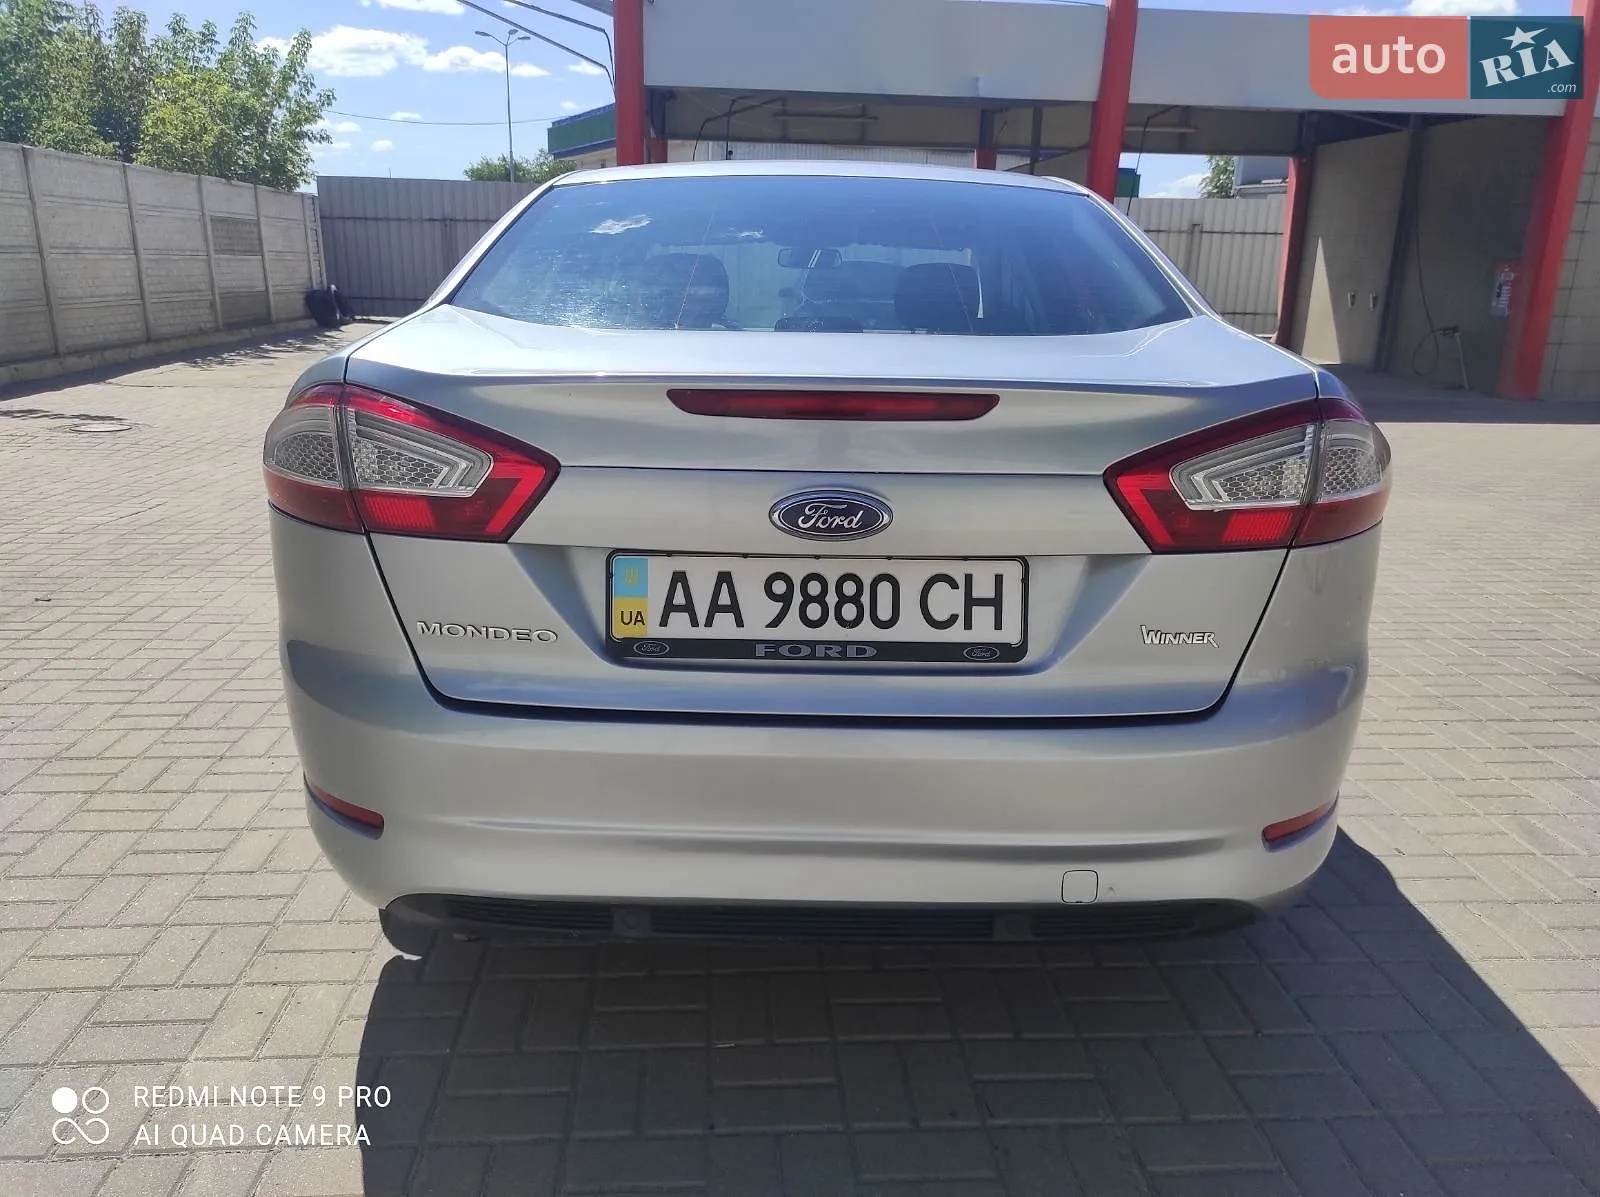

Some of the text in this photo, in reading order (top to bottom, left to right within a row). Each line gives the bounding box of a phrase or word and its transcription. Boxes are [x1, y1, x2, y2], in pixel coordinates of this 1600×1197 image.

[797, 503, 862, 530] Ford
[659, 571, 1004, 631] AA 9880 CH
[620, 611, 646, 626] UA
[416, 621, 558, 643] MONDEO
[755, 643, 878, 659] FORD
